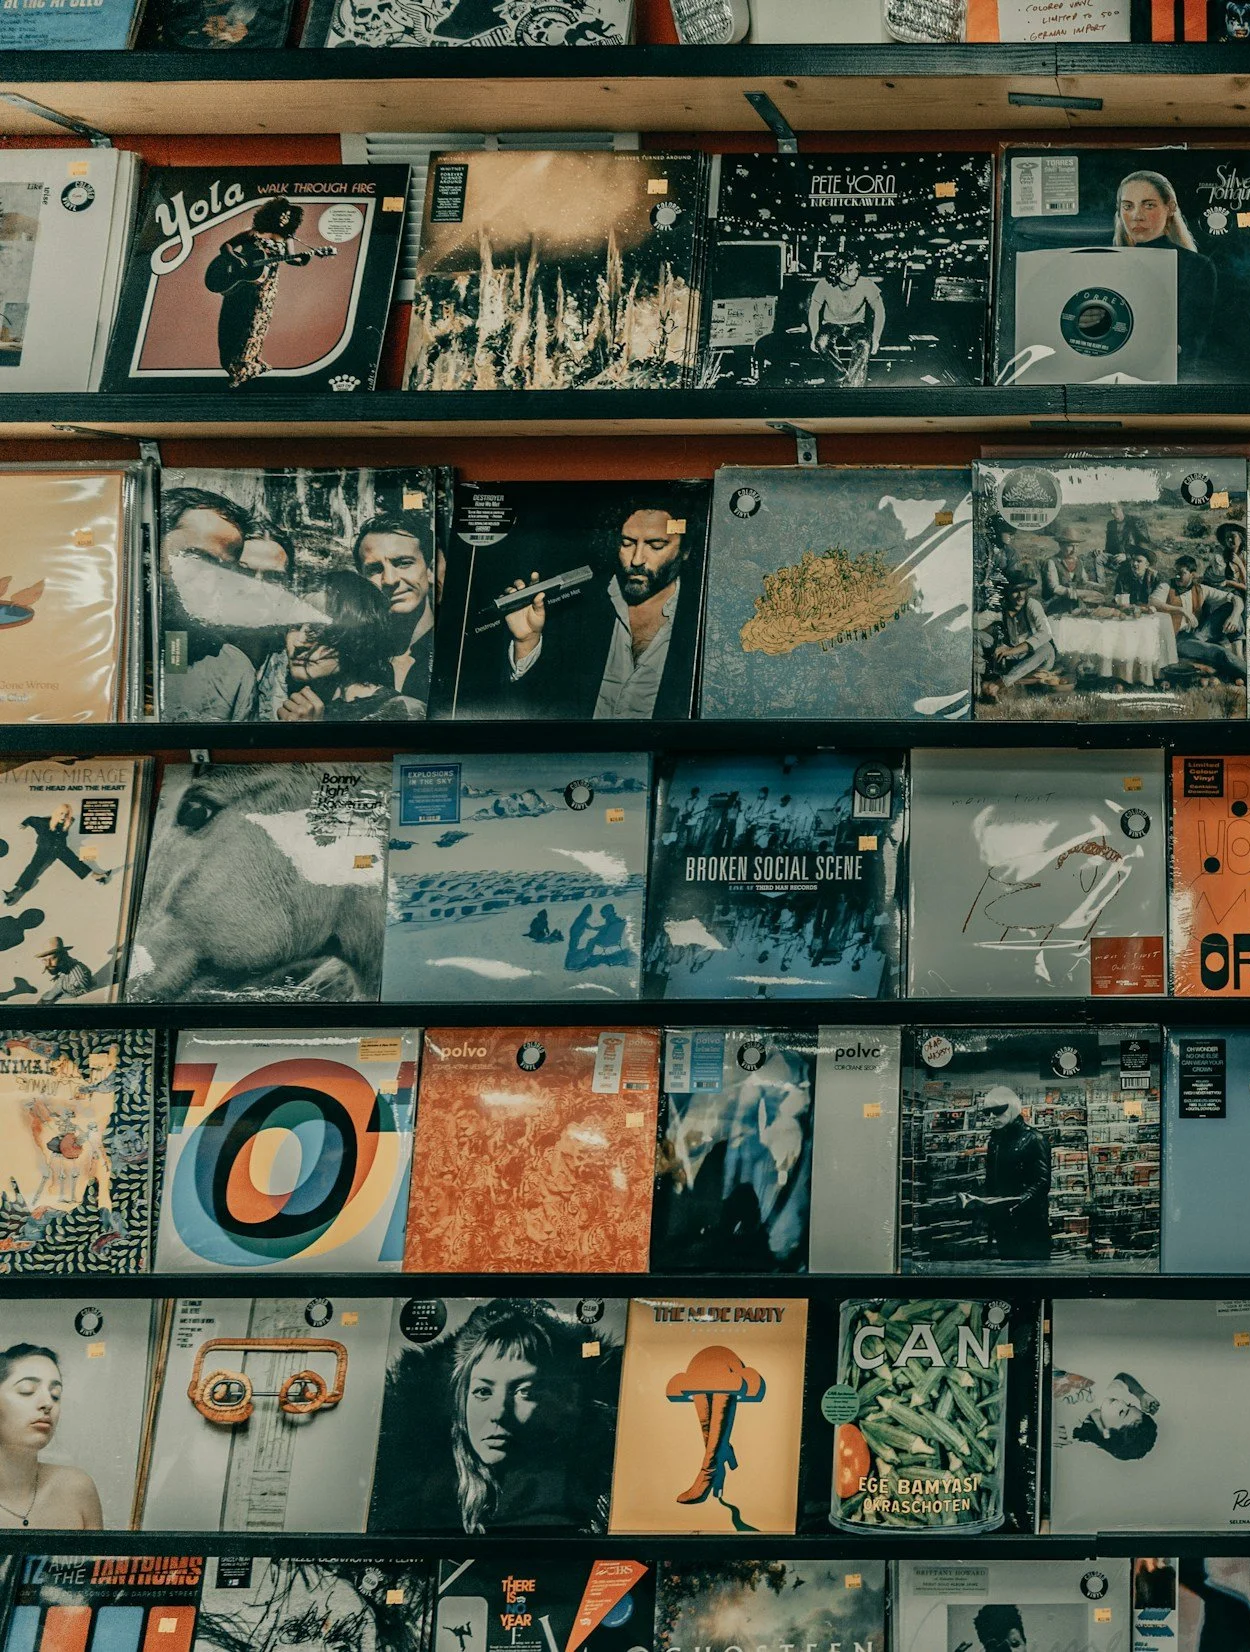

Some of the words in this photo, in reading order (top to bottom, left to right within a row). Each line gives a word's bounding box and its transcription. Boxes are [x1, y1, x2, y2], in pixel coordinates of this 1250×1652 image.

[1026, 1, 1063, 11] COLORED
[1043, 14, 1077, 23] LIMITED
[1029, 30, 1066, 41] GERMAN
[1073, 24, 1105, 34] IMPORT
[257, 183, 290, 195] WALK
[293, 182, 348, 194] THROUGH
[351, 182, 376, 194] FIRE
[810, 175, 841, 194] PETE
[846, 175, 896, 194] YORN
[810, 198, 895, 207] NIGHTCRAWLER
[1204, 207, 1230, 217] COLORED
[151, 180, 244, 275] Yola
[1208, 226, 1229, 235] VINYL
[475, 620, 501, 634] Destroyer
[547, 595, 561, 605] Have
[26, 680, 59, 692] Wrong
[63, 769, 127, 784] MIRAGE
[322, 773, 361, 787] Bonny
[408, 771, 454, 779] EXPLOSIONS
[320, 784, 350, 797] Light
[687, 855, 748, 881] BROKEN
[754, 855, 809, 881] SOCIAL
[817, 855, 862, 880] SCENE
[442, 1042, 487, 1061] polvo
[654, 1307, 684, 1322] THE
[687, 1307, 730, 1323] NUDE
[734, 1307, 785, 1323] PARTY
[853, 1323, 991, 1370] CAN
[859, 1477, 888, 1494] EGE
[899, 1476, 978, 1495] BAMYASI
[864, 1498, 970, 1514] OKRASCHOTEN
[52, 1570, 85, 1585] THE
[502, 1579, 536, 1592] THERE
[507, 1591, 516, 1603] IS
[506, 1604, 526, 1615] NO
[500, 1613, 532, 1627] YEAR
